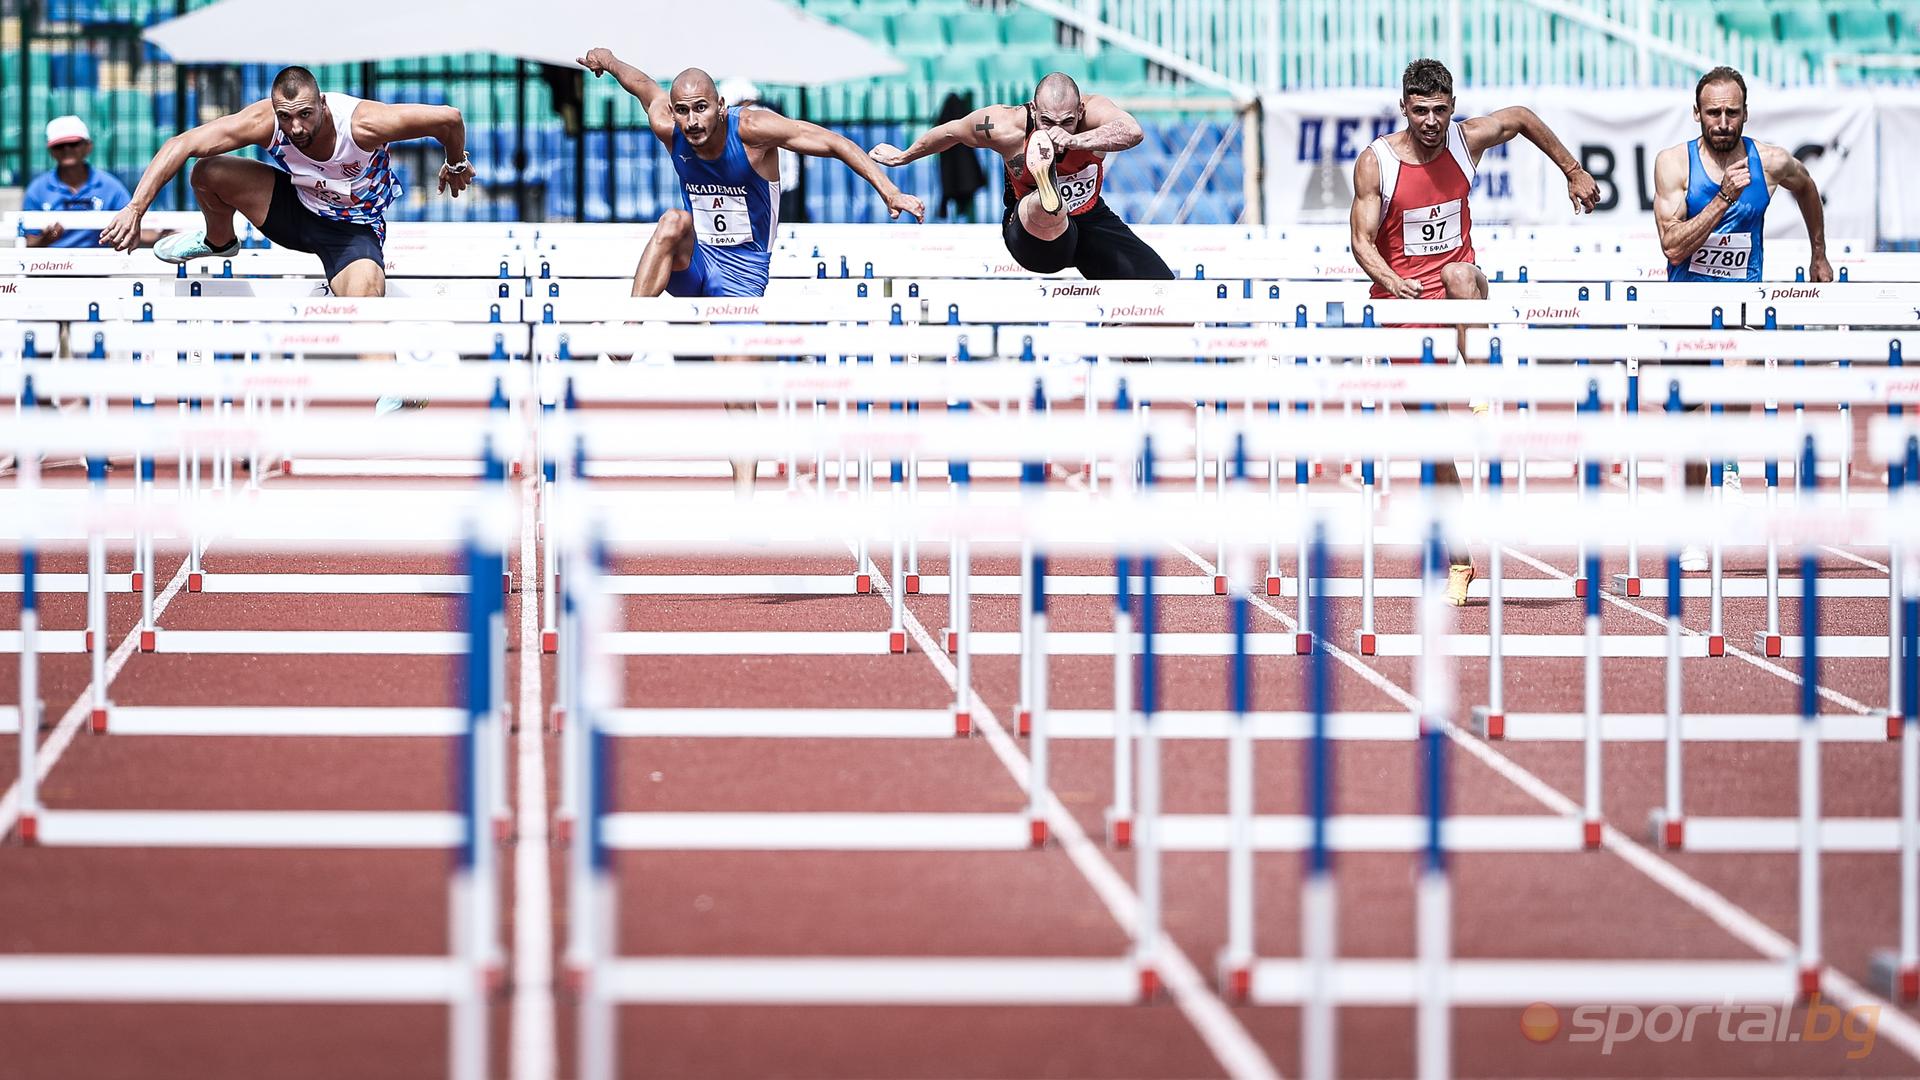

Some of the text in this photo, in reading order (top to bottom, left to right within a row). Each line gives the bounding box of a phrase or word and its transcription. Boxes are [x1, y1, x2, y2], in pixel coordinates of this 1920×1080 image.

[685, 183, 748, 195] AKADEMIK
[1060, 178, 1095, 202] 939
[713, 213, 727, 232] 6
[1421, 220, 1447, 241] 97
[1694, 248, 1746, 267] 2780
[30, 261, 73, 272] polanik
[1052, 285, 1101, 298] polanik
[1771, 287, 1820, 300] polanik
[304, 303, 358, 317] polanik
[705, 304, 760, 317] polanik
[1110, 305, 1165, 318] polanik
[1526, 306, 1581, 320] polanik
